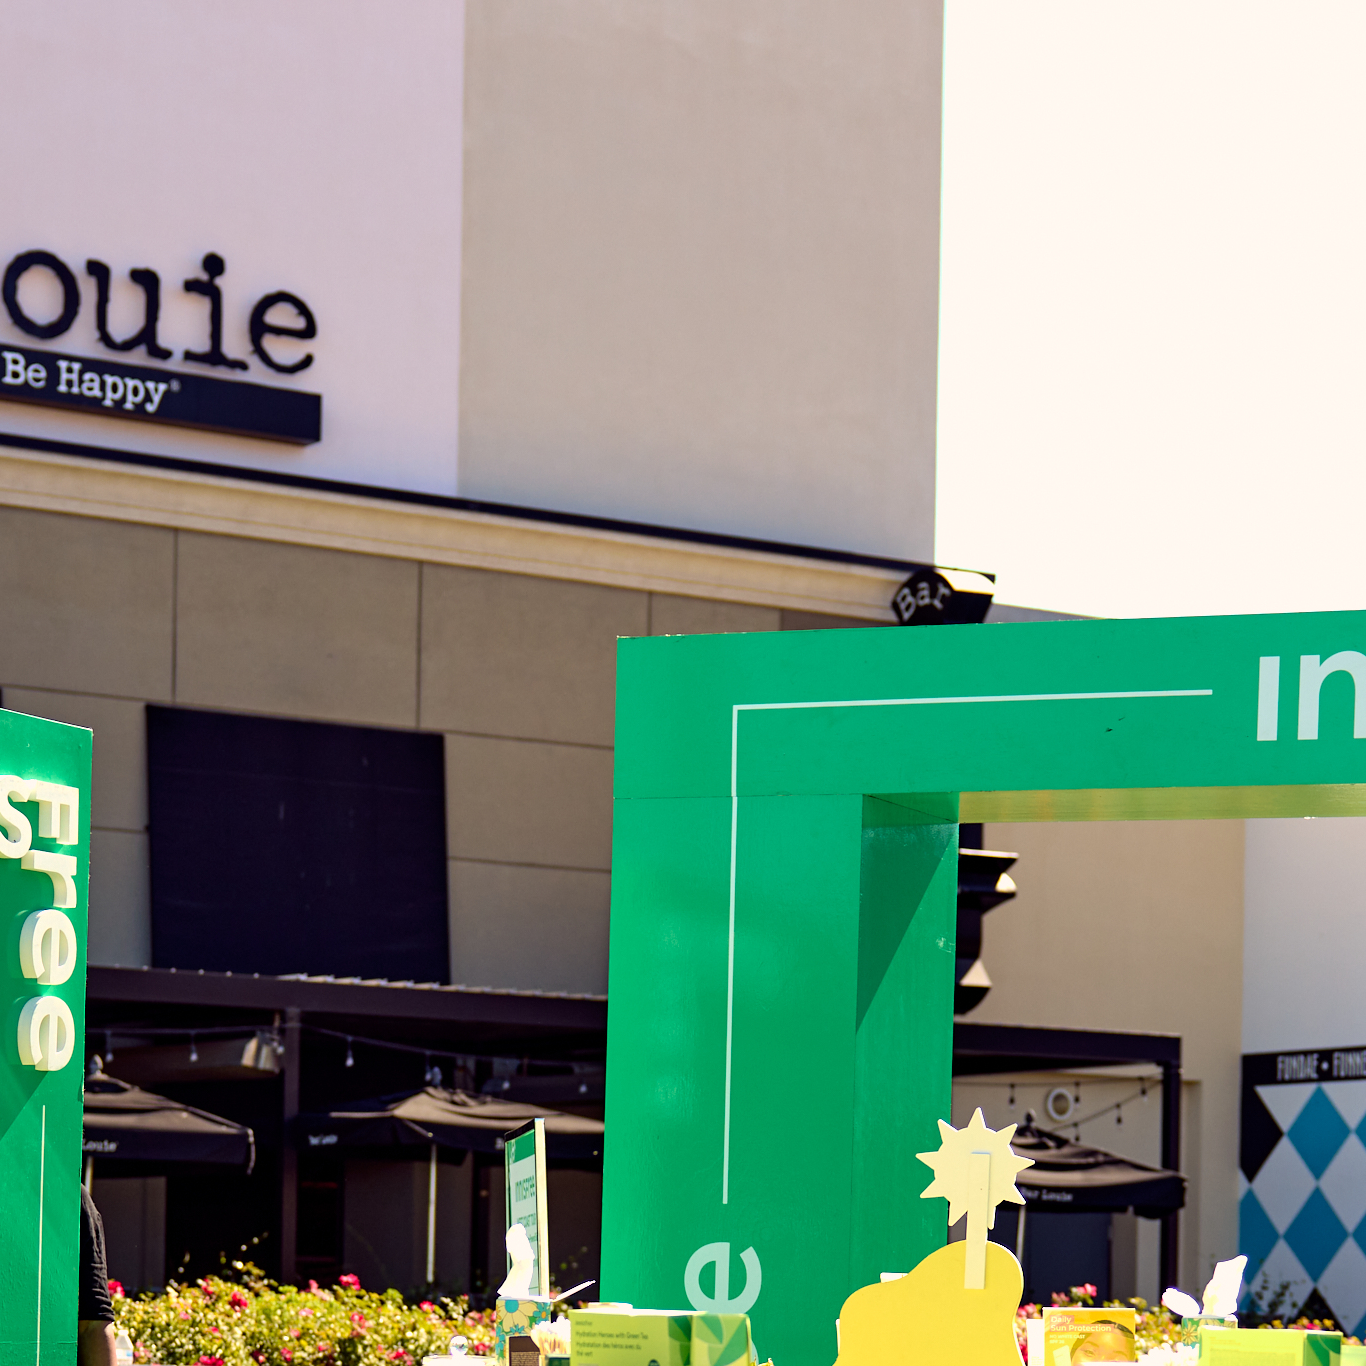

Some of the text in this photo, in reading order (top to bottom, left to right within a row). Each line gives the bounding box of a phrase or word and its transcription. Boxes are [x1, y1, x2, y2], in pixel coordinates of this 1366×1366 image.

[2, 350, 48, 388] Be
[896, 581, 952, 623] Bar
[1277, 1053, 1320, 1081] FUNDAE
[1051, 1315, 1071, 1324] Daily
[1069, 1324, 1112, 1332] Protection
